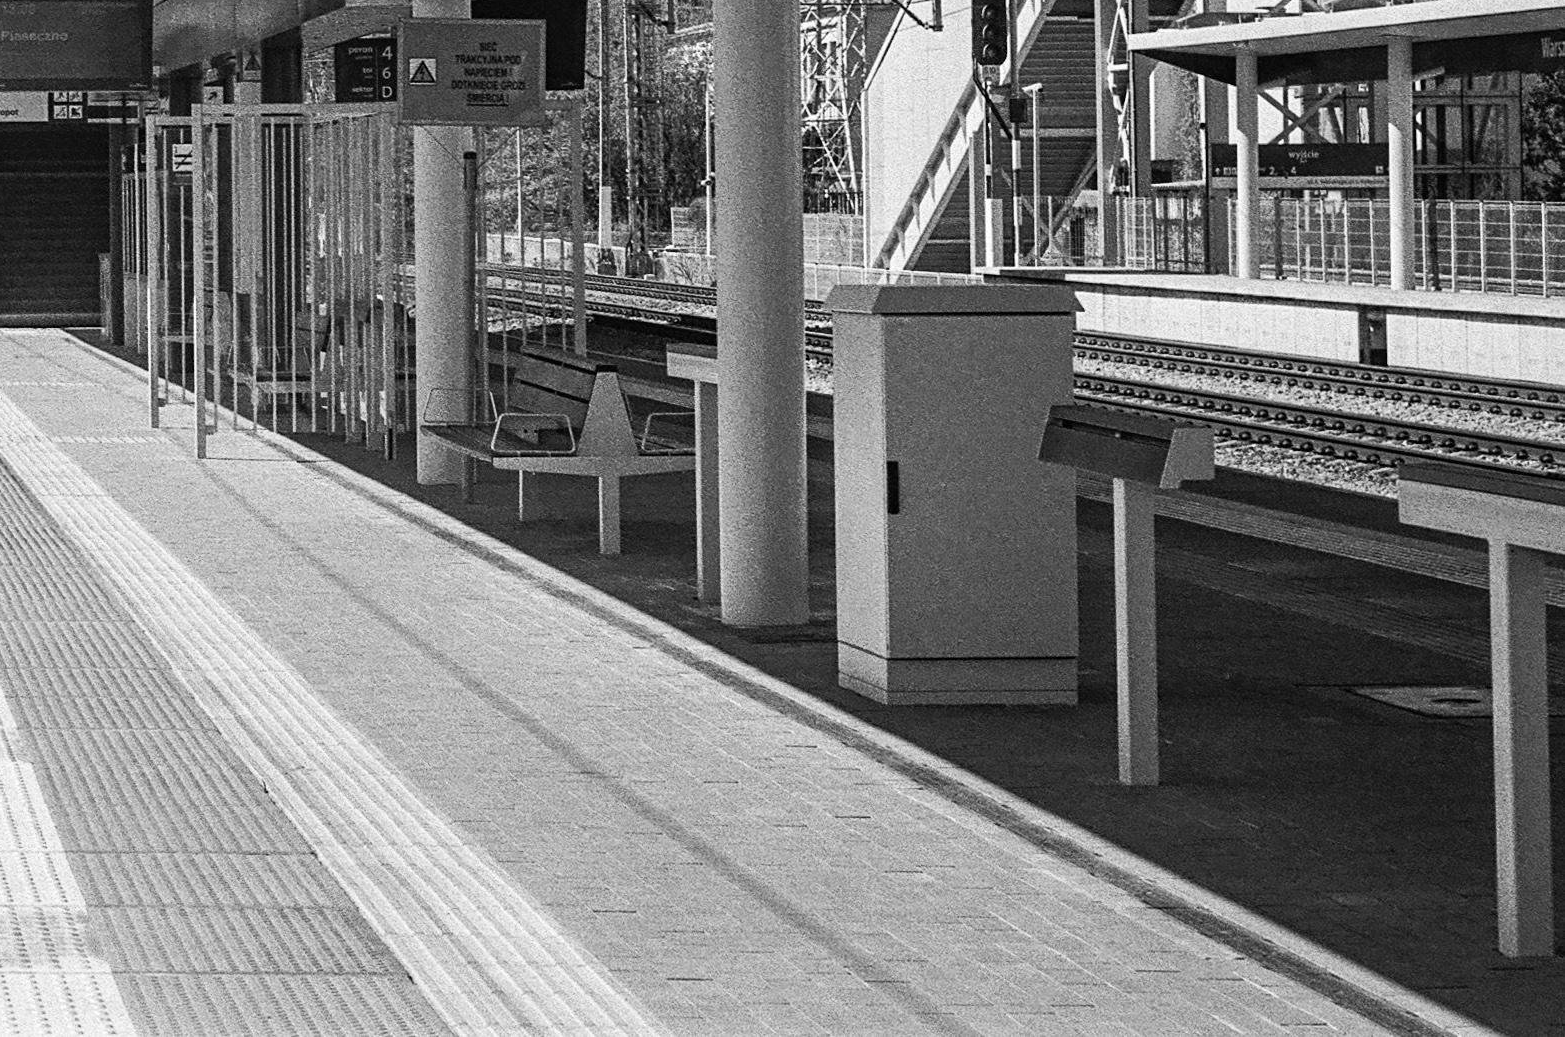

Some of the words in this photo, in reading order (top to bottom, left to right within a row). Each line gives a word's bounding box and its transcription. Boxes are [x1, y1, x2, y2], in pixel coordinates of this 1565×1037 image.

[382, 46, 393, 61] 4
[382, 67, 392, 80] 6
[381, 86, 393, 99] D
[1288, 149, 1319, 161] wyjście
